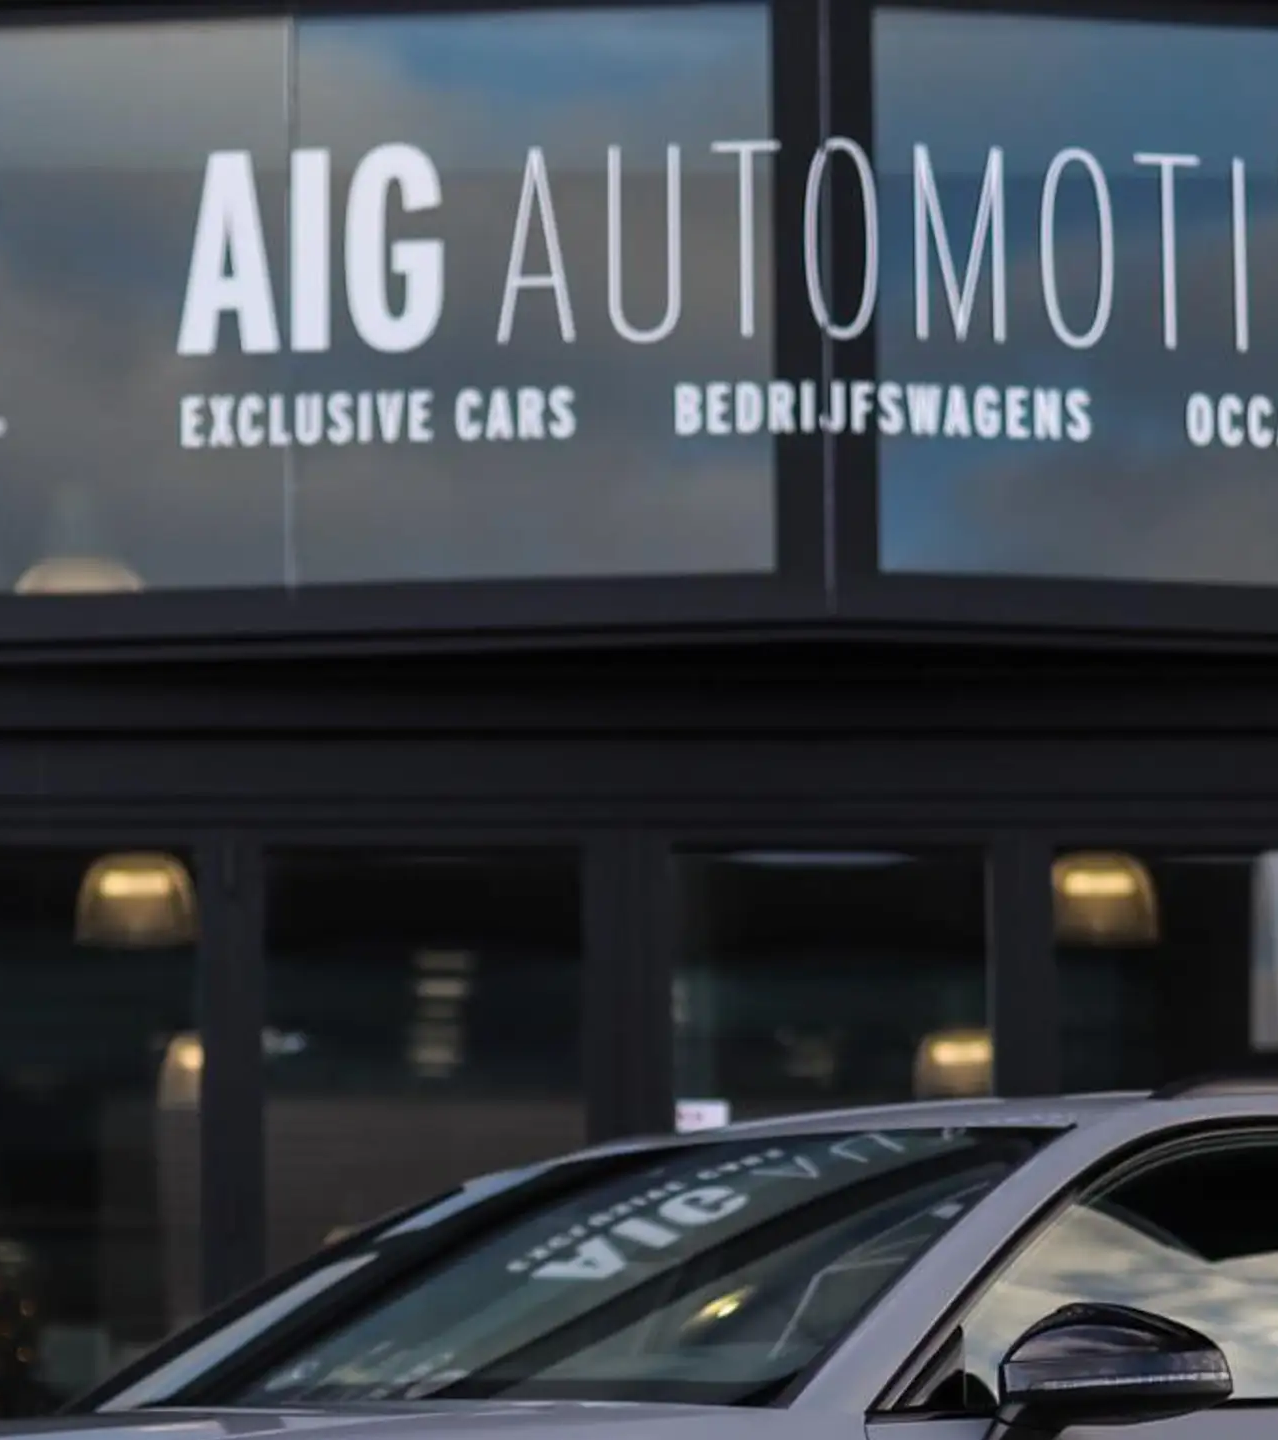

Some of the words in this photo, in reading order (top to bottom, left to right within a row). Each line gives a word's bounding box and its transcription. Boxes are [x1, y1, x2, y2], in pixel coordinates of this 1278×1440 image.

[178, 143, 443, 355] AIG
[180, 391, 432, 448] EXCLUSIVE
[455, 387, 576, 441] CARS
[674, 381, 1092, 442] BEDRIJFSWAGENS
